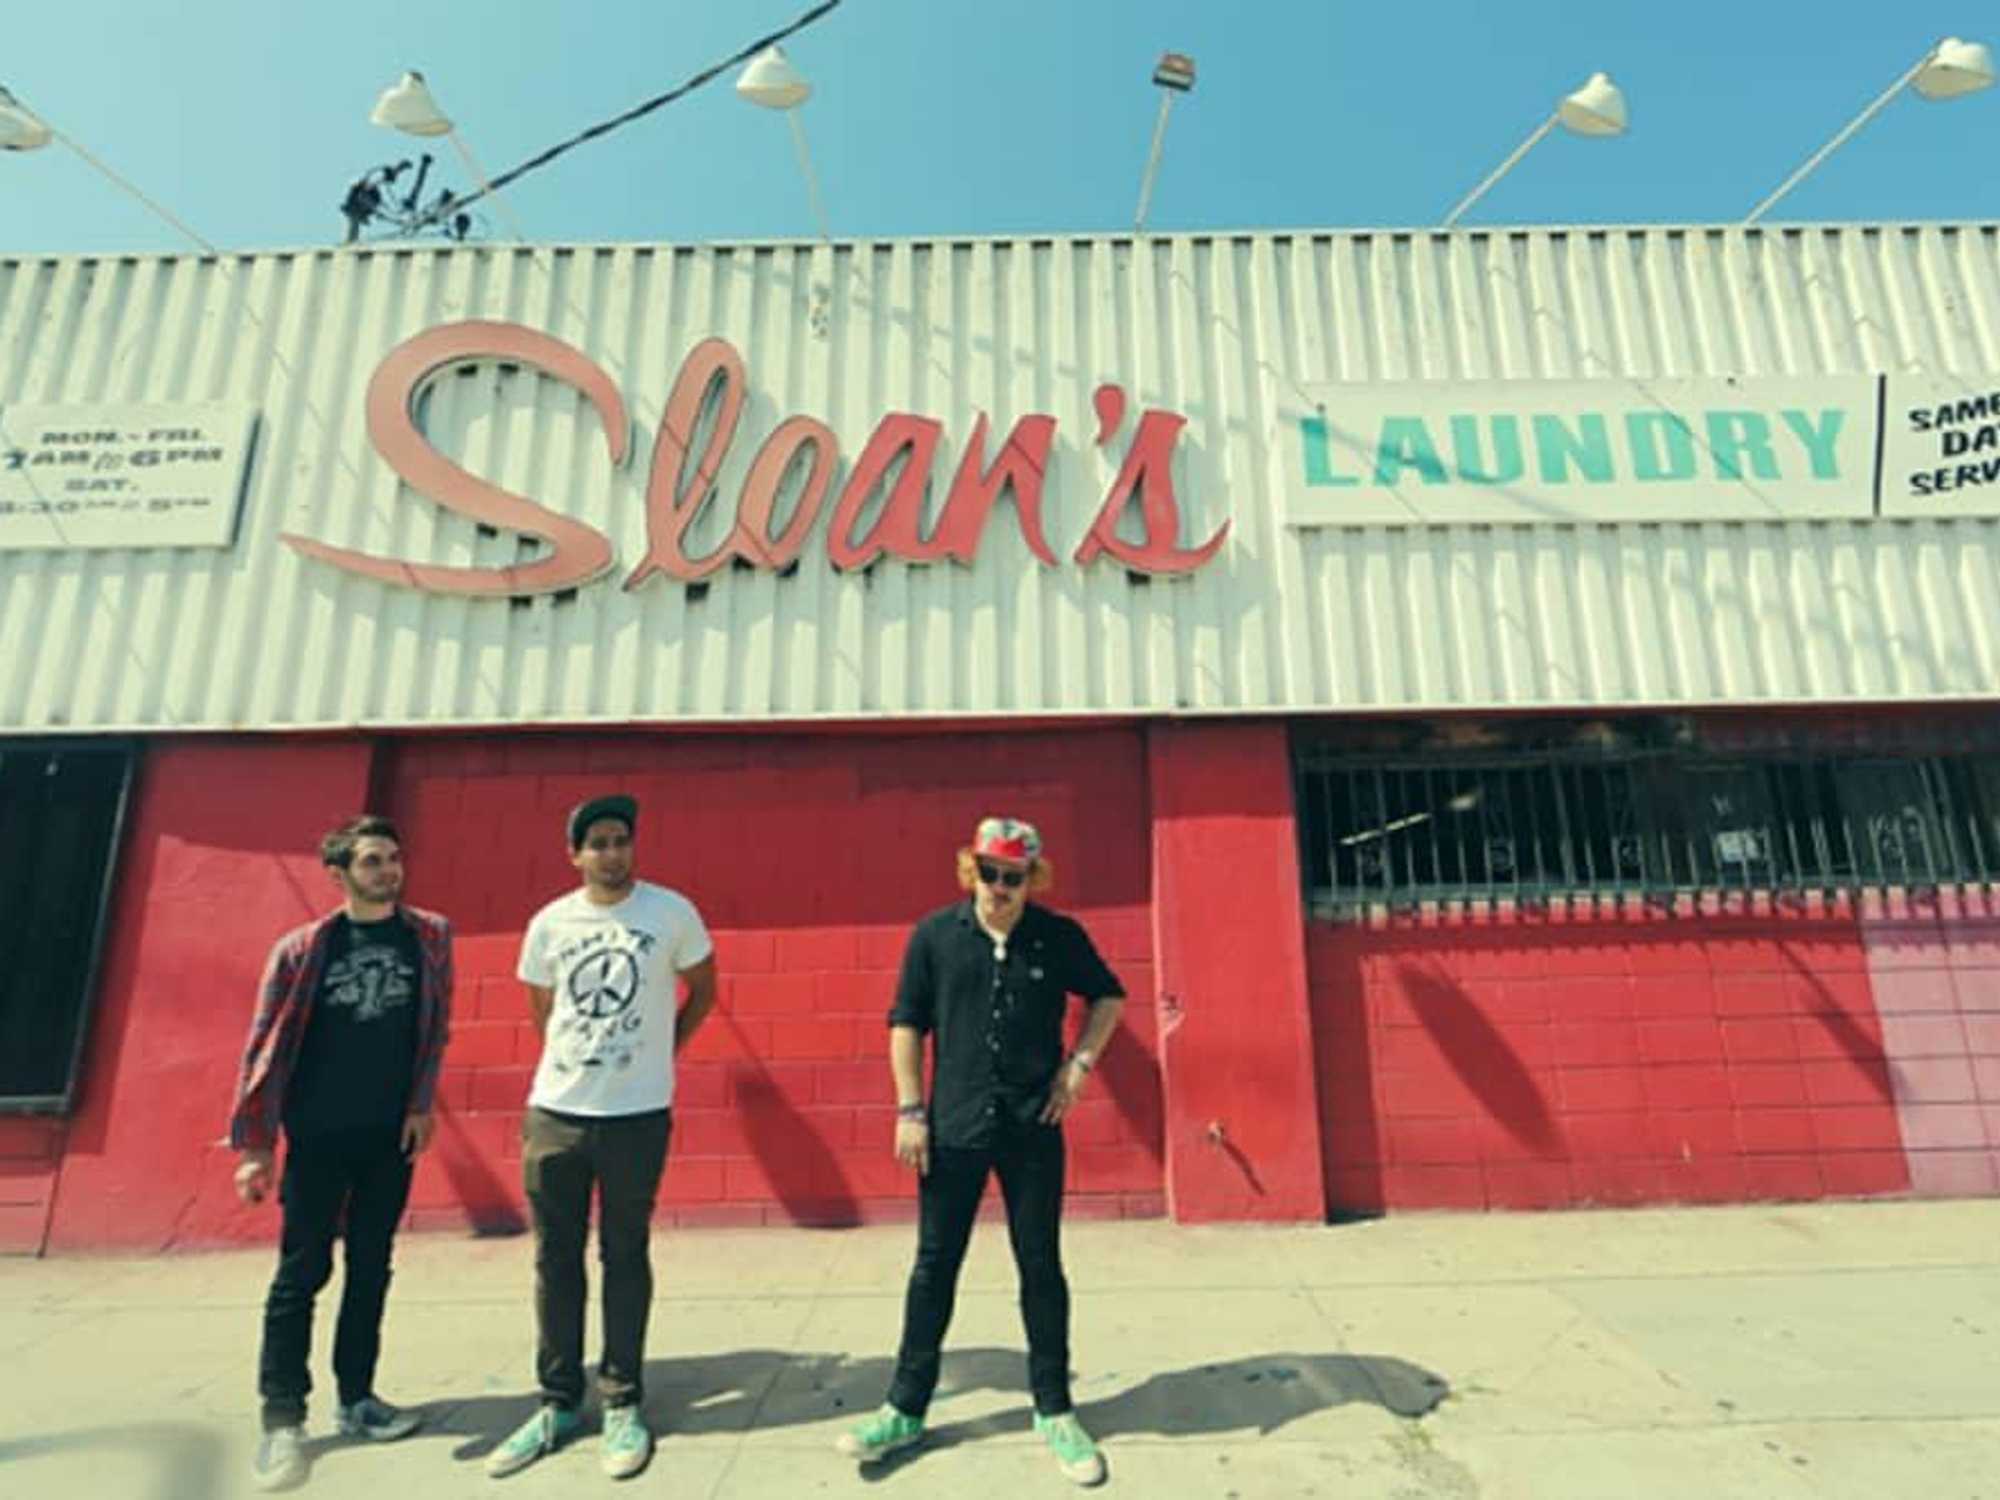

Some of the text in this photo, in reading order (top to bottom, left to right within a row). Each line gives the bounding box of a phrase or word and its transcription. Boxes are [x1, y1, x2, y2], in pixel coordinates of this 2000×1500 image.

[278, 319, 1232, 596] Sloan's
[1301, 407, 1845, 488] LAUNDRY
[1942, 425, 2000, 457] DA
